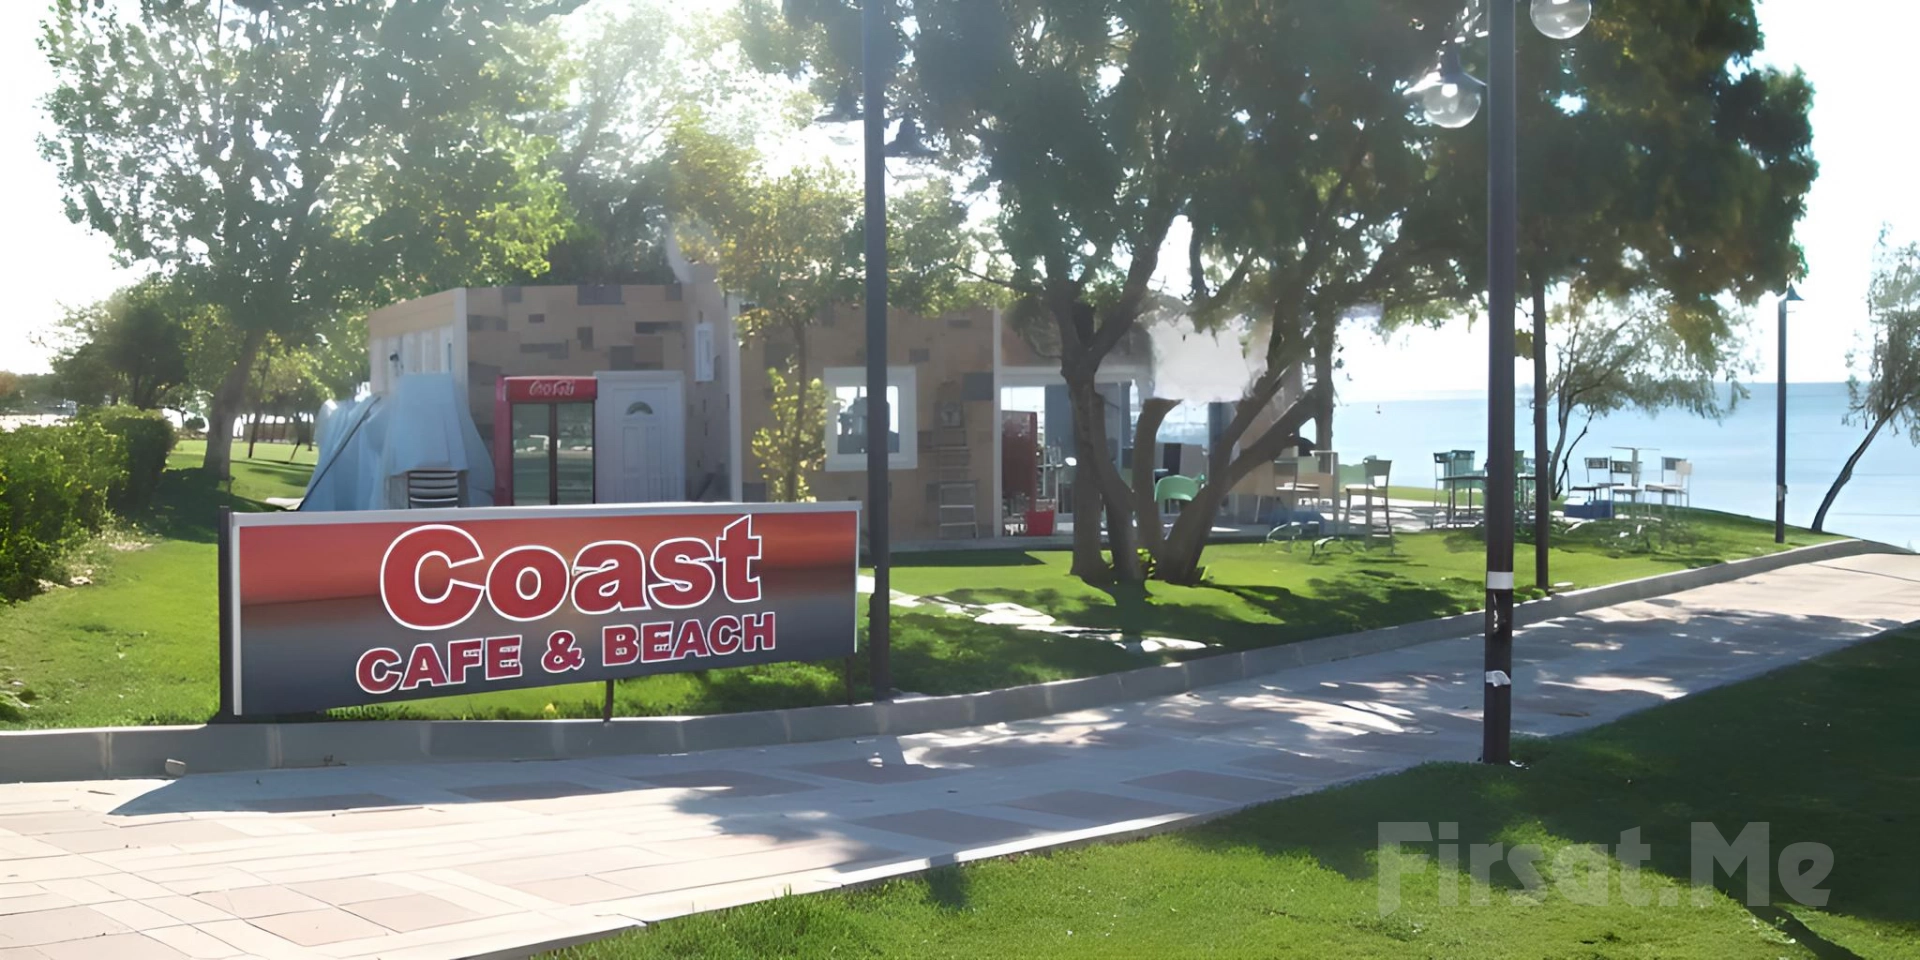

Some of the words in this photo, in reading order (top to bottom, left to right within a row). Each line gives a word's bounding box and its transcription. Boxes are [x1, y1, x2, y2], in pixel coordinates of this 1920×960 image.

[380, 514, 762, 631] Coast
[355, 635, 523, 694] CAFE
[541, 631, 585, 674] &
[602, 612, 777, 667] BEACH
